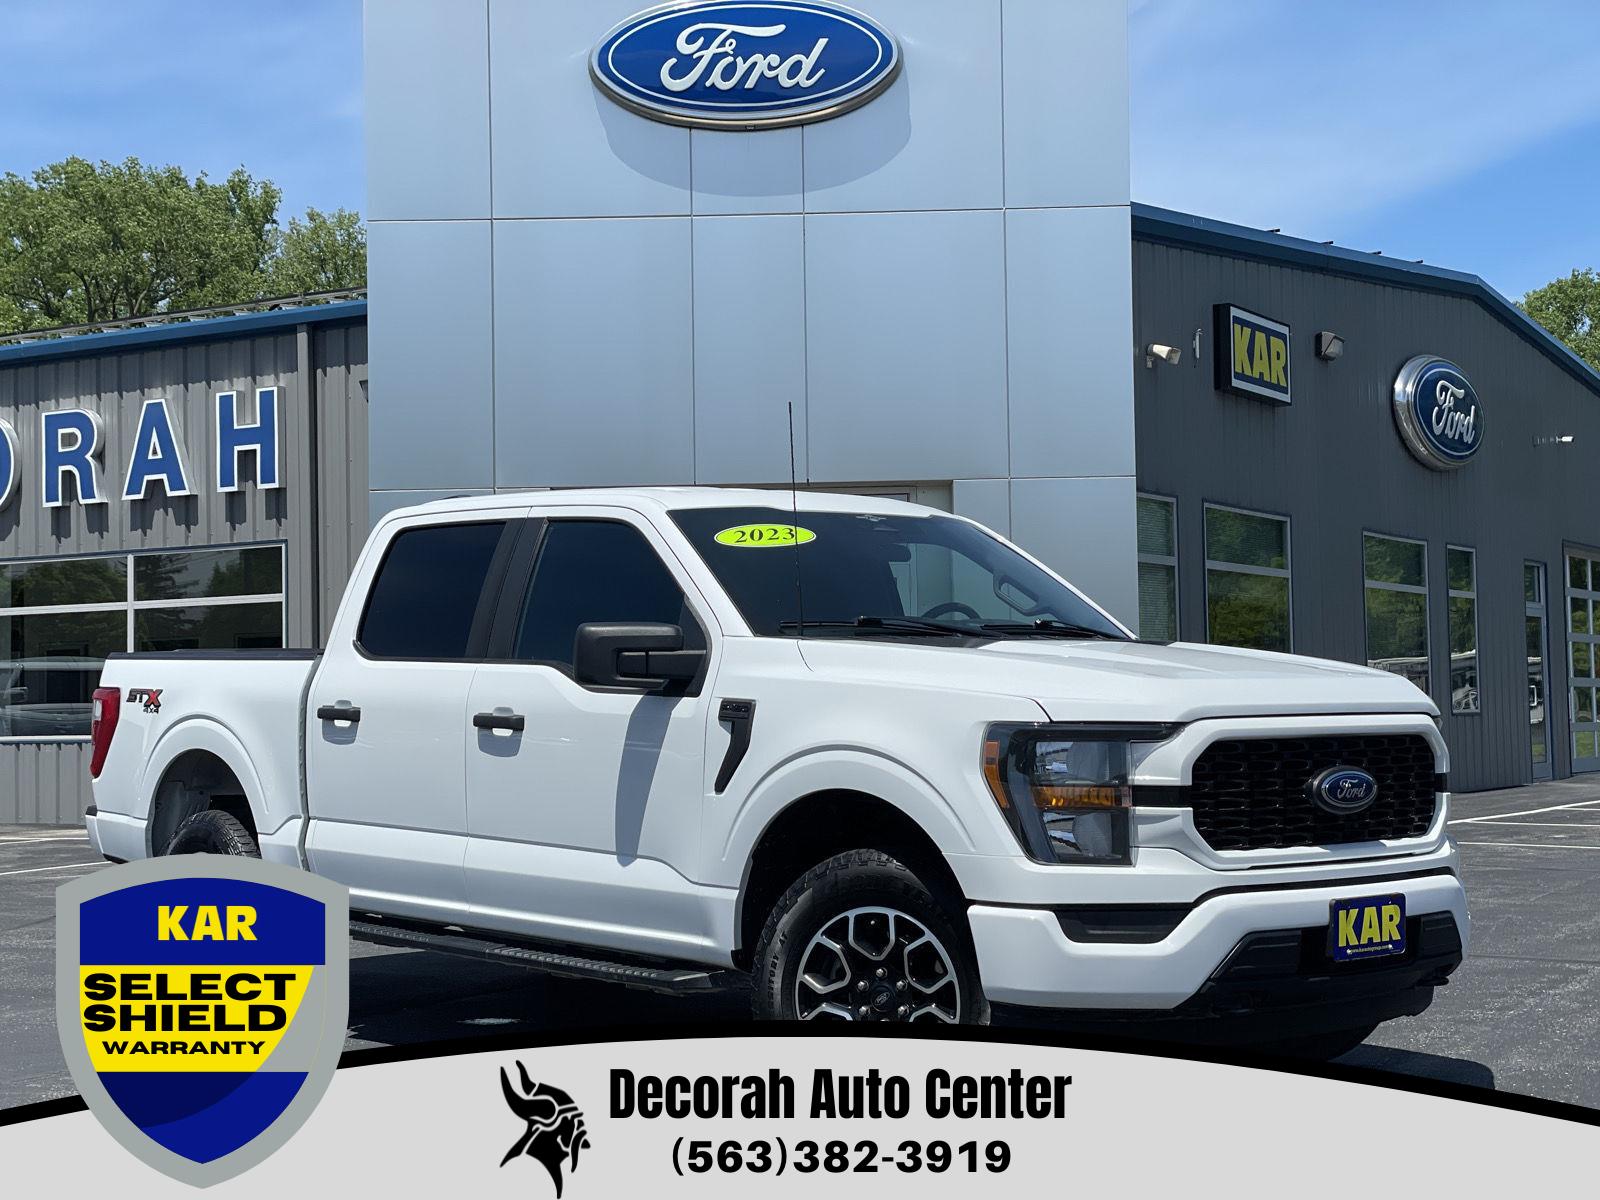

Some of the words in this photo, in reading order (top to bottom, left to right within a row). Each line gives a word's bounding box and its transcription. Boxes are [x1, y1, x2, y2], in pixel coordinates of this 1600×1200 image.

[660, 22, 829, 92] Ford
[1233, 323, 1288, 388] KAR
[1432, 380, 1476, 444] Ford
[0, 386, 284, 507] RAH
[733, 527, 796, 544] 2023
[126, 688, 164, 708] STX
[1337, 778, 1366, 799] Ford
[1338, 904, 1402, 948] KAR
